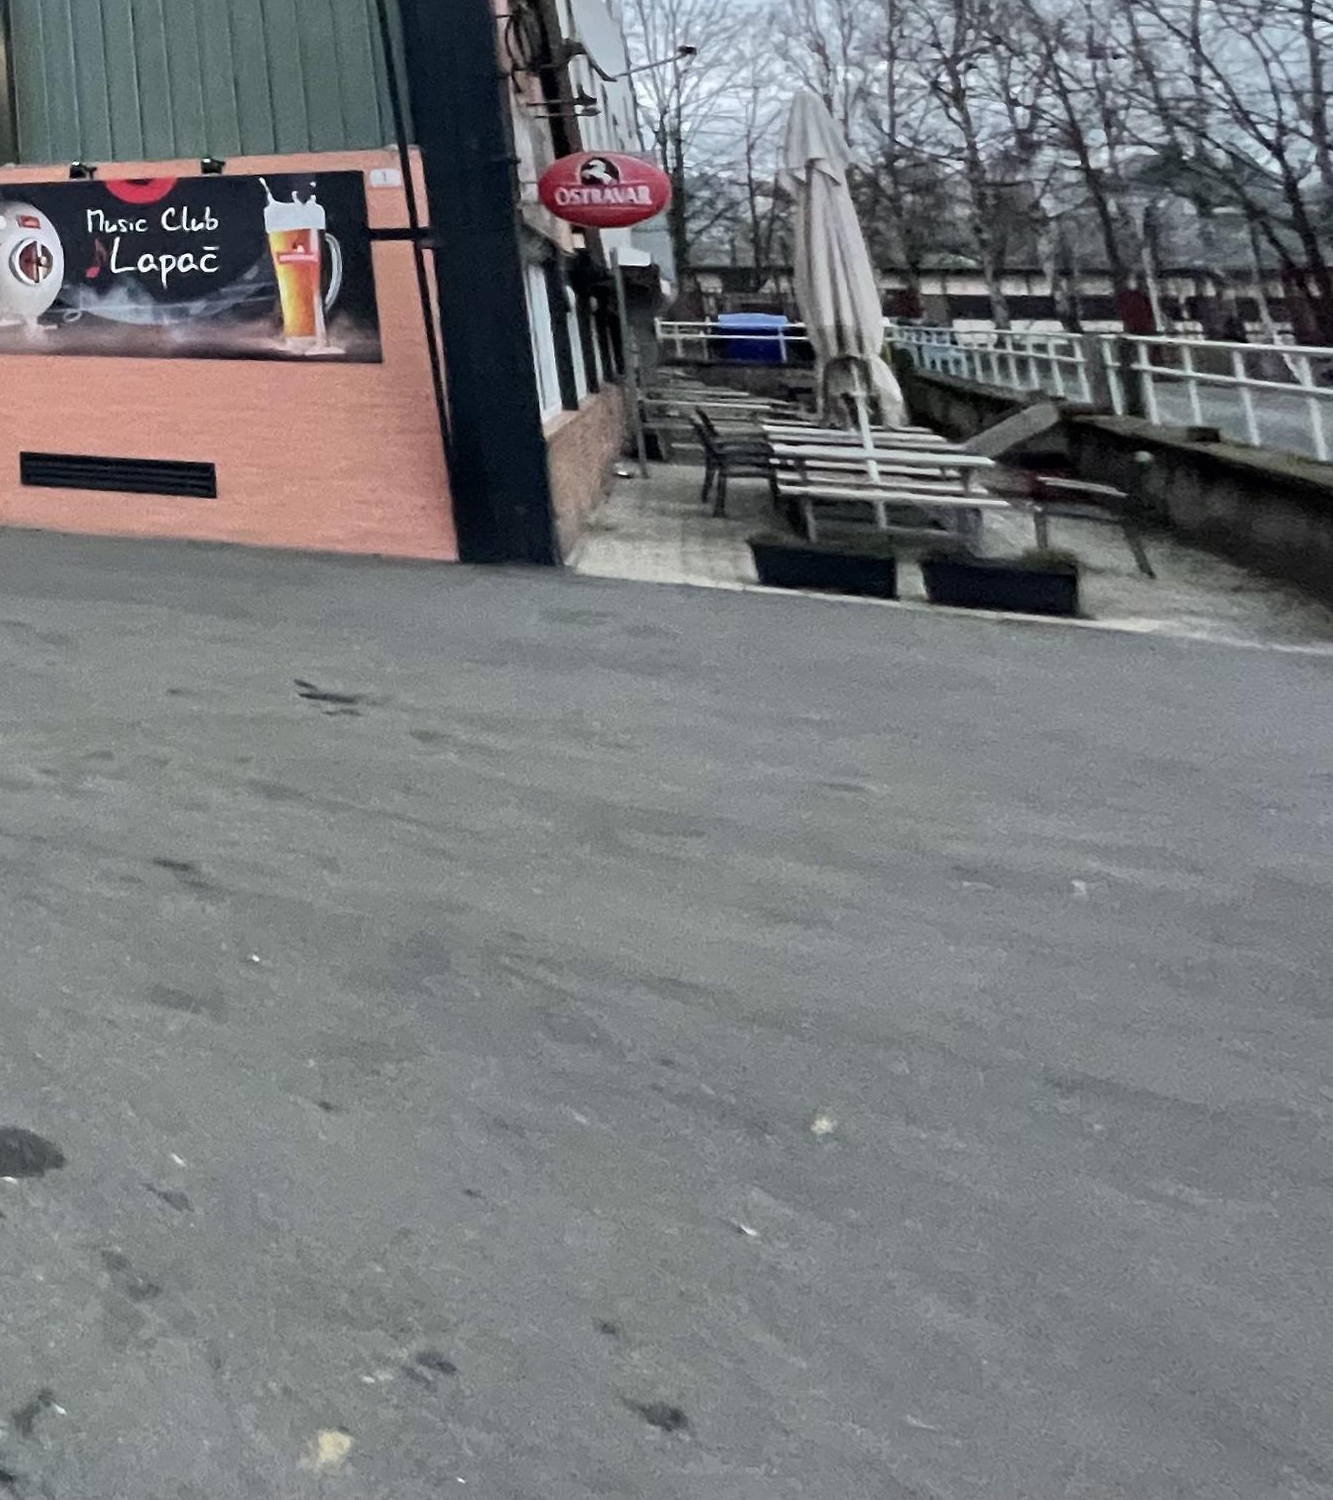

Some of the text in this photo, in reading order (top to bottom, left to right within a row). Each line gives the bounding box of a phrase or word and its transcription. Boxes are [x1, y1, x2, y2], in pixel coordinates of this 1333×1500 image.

[554, 184, 653, 206] OSTRAVAR
[85, 205, 220, 233] Music Club
[109, 236, 220, 290] Lapač
